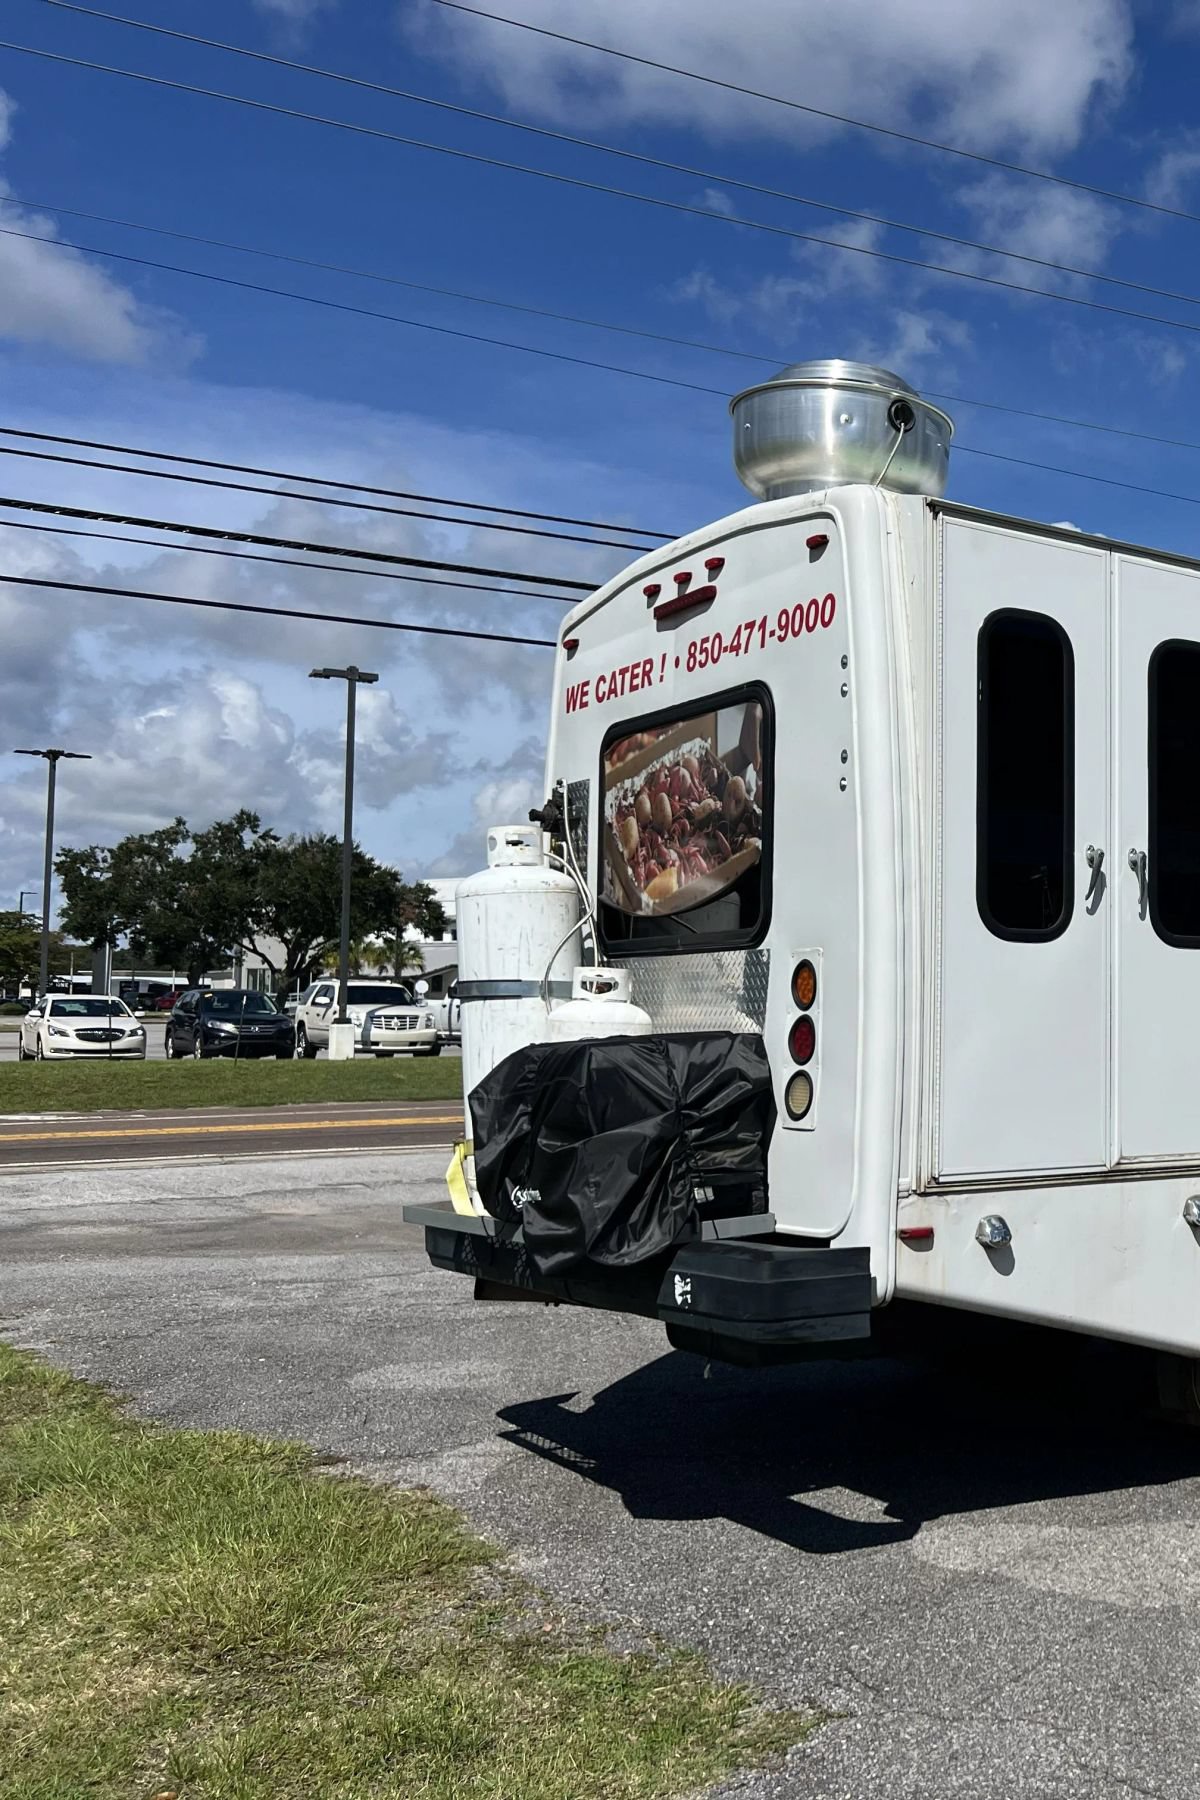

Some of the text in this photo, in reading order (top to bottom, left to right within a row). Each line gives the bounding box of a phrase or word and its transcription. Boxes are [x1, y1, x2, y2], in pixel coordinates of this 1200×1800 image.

[566, 680, 590, 713] WE
[595, 658, 653, 703] CATER
[686, 593, 836, 672] 850-471-9000
